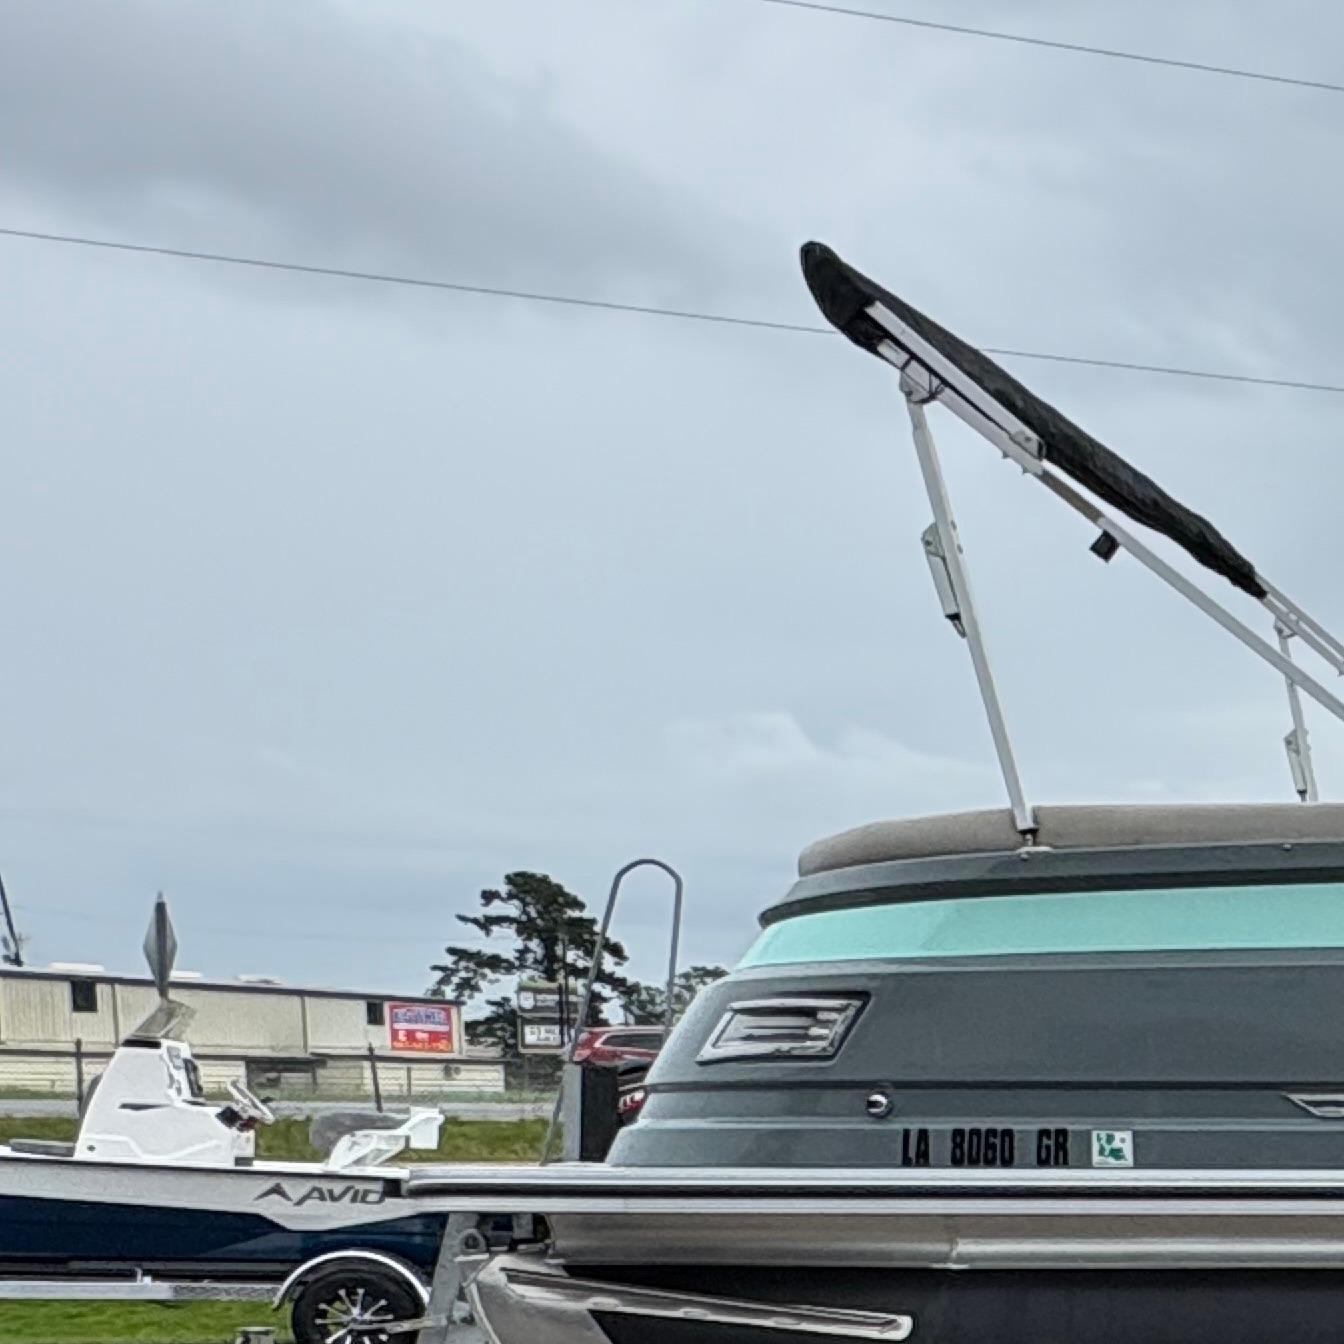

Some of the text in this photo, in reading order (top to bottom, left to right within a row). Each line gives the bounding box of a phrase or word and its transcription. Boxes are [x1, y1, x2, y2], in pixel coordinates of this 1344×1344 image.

[902, 1128, 930, 1167] LA
[951, 1128, 1014, 1167] 8060
[1037, 1128, 1070, 1166] GR
[293, 1184, 386, 1206] AVID
